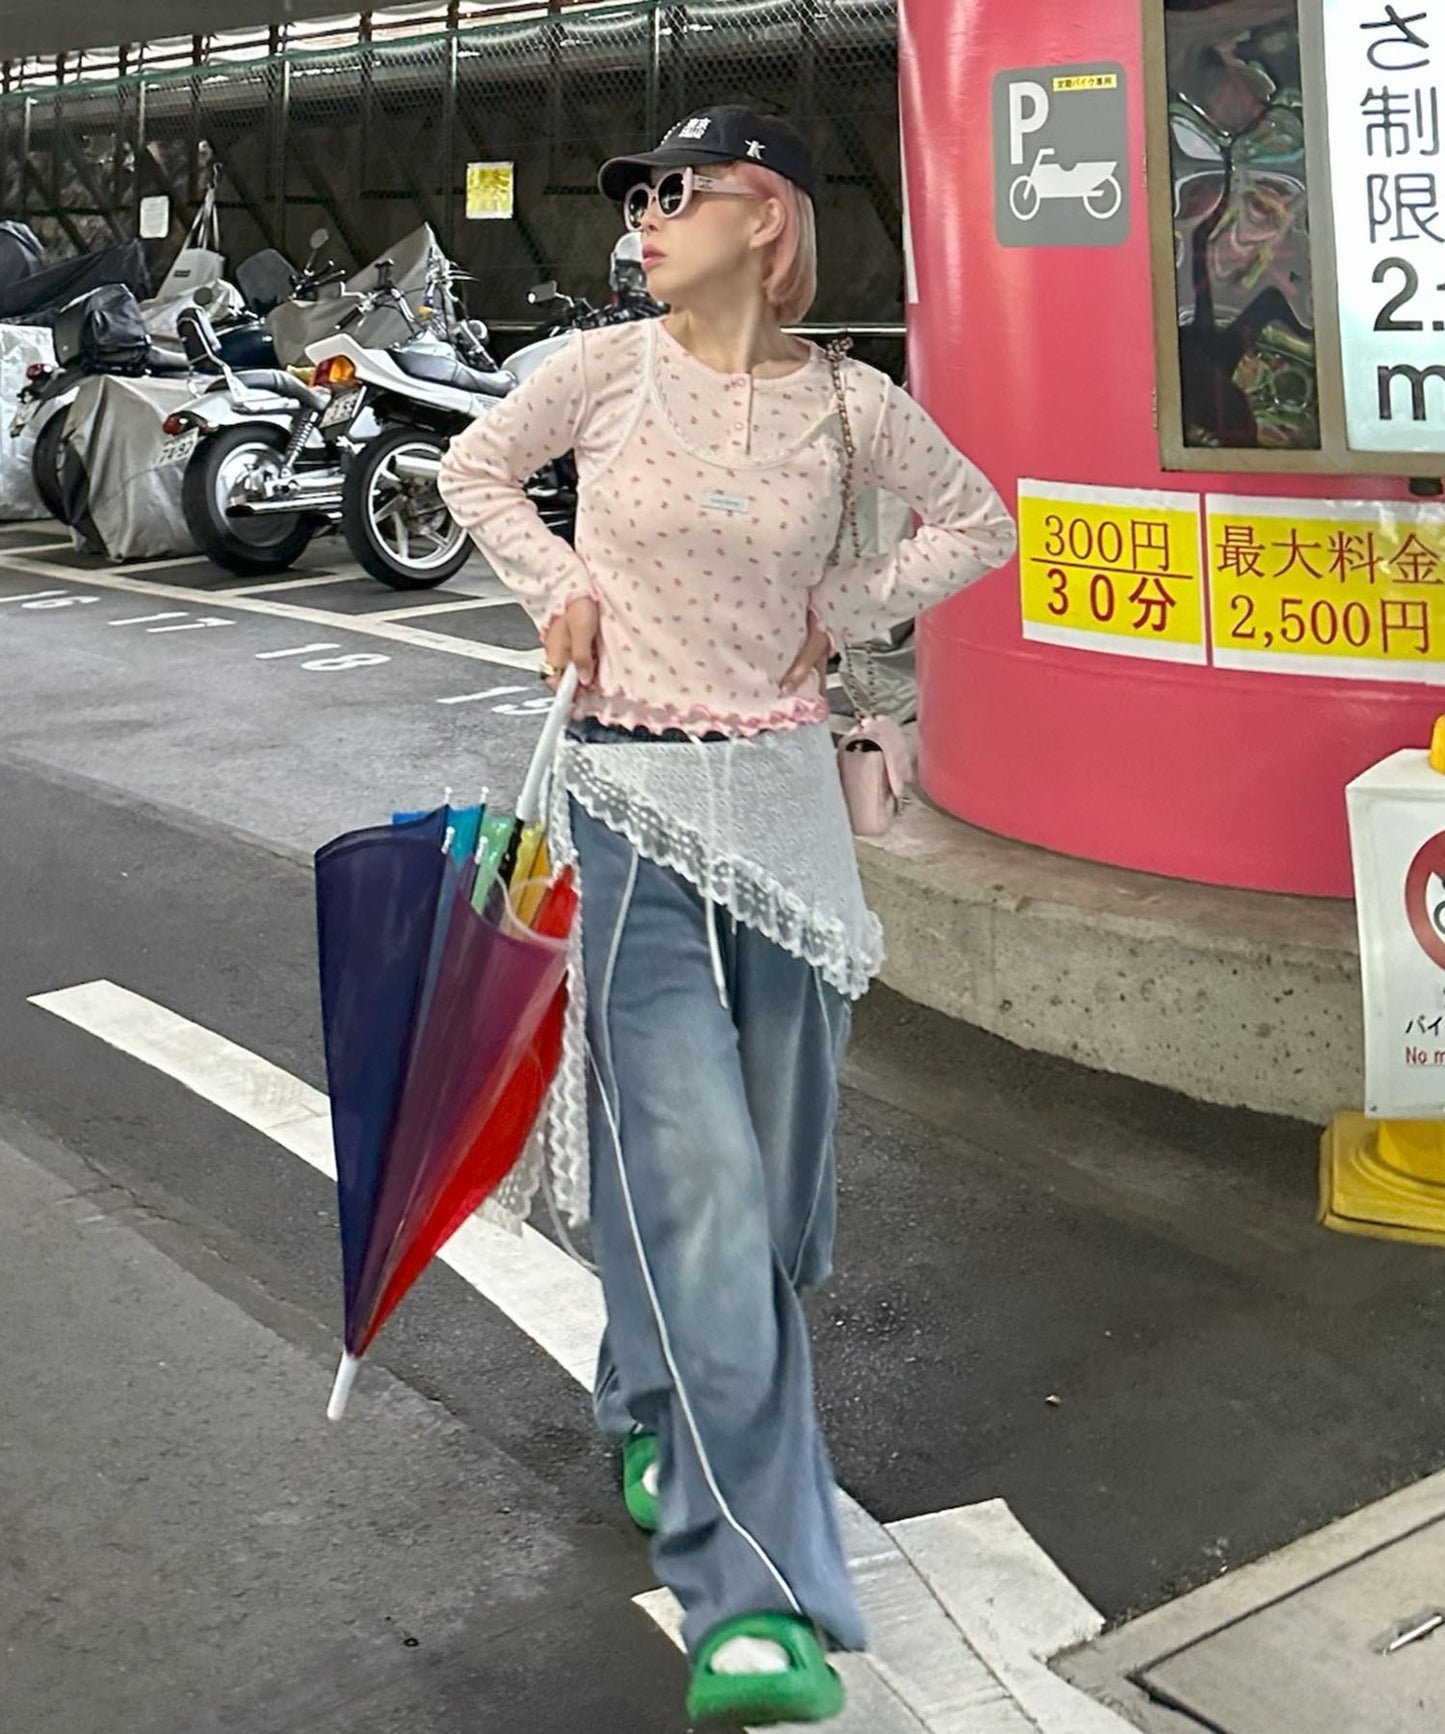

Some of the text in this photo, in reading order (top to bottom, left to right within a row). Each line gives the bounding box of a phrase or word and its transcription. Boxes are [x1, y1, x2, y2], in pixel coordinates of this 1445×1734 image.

[1009, 82, 1049, 165] P
[1044, 514, 1169, 572] 300円
[1215, 524, 1445, 585] 最大料金
[107, 611, 238, 633] 17
[1046, 567, 1177, 632] 30分
[1230, 594, 1429, 654] 2,500円
[255, 643, 391, 671] 18
[1405, 1046, 1427, 1065] No
